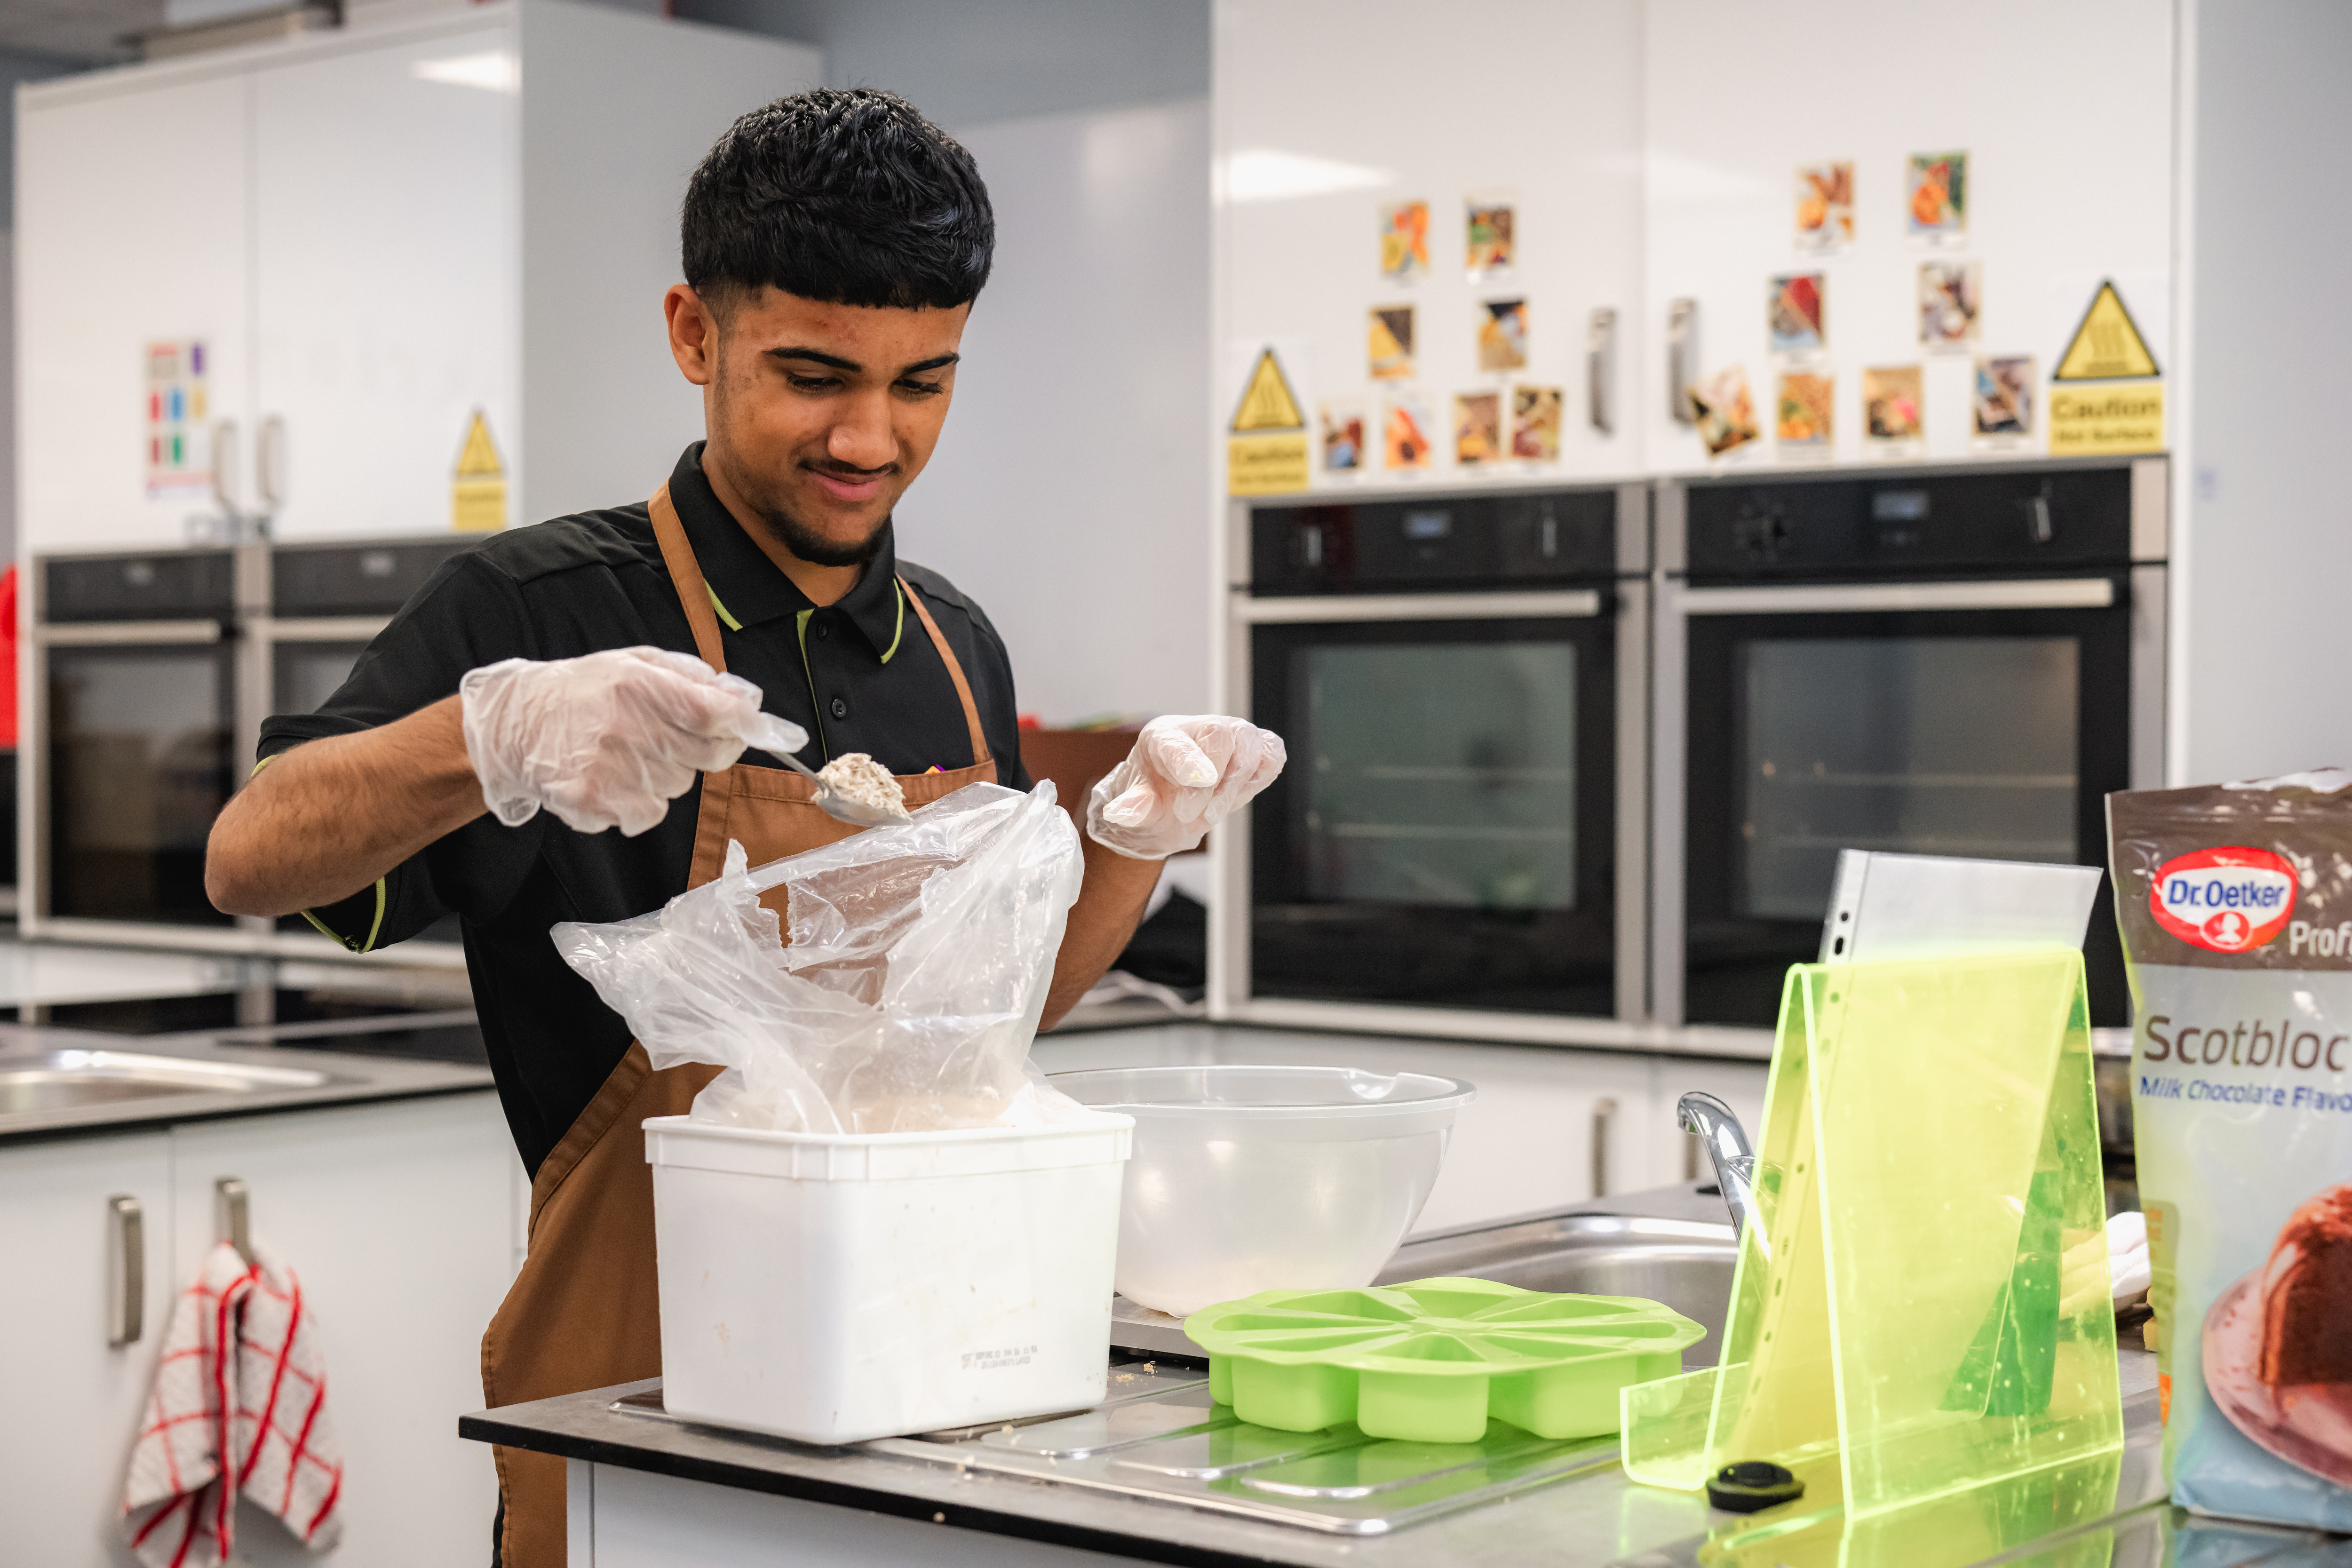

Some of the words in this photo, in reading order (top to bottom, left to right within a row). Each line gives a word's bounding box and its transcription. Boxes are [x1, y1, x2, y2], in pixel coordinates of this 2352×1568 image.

[2052, 395, 2161, 422] Caution
[2289, 920, 2352, 957] Prof
[2143, 1014, 2350, 1073] Scotbloc
[2139, 1075, 2183, 1099] Milk
[2187, 1079, 2286, 1107] Chocolate
